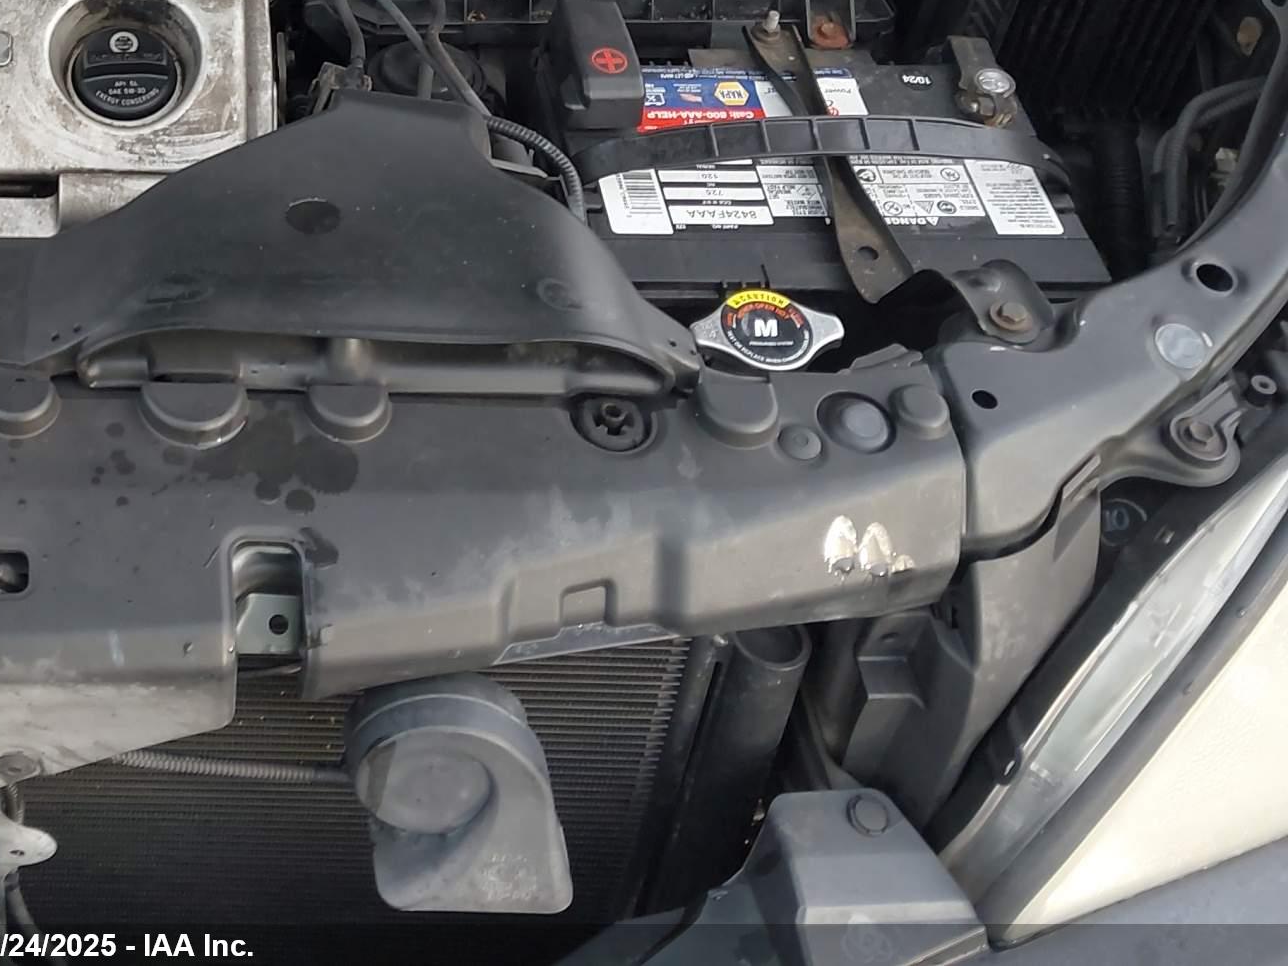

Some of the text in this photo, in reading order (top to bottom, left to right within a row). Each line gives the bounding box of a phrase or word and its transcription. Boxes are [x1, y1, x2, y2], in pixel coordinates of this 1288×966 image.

[901, 74, 931, 85] 10/24
[95, 87, 160, 106] ENERGY CONSERVING
[719, 89, 744, 101] NAPA
[729, 110, 755, 120] Call:
[685, 209, 757, 219] 8424FAAA
[884, 217, 927, 225] DANGE
[740, 292, 785, 306] CAUTION
[754, 319, 778, 338] M
